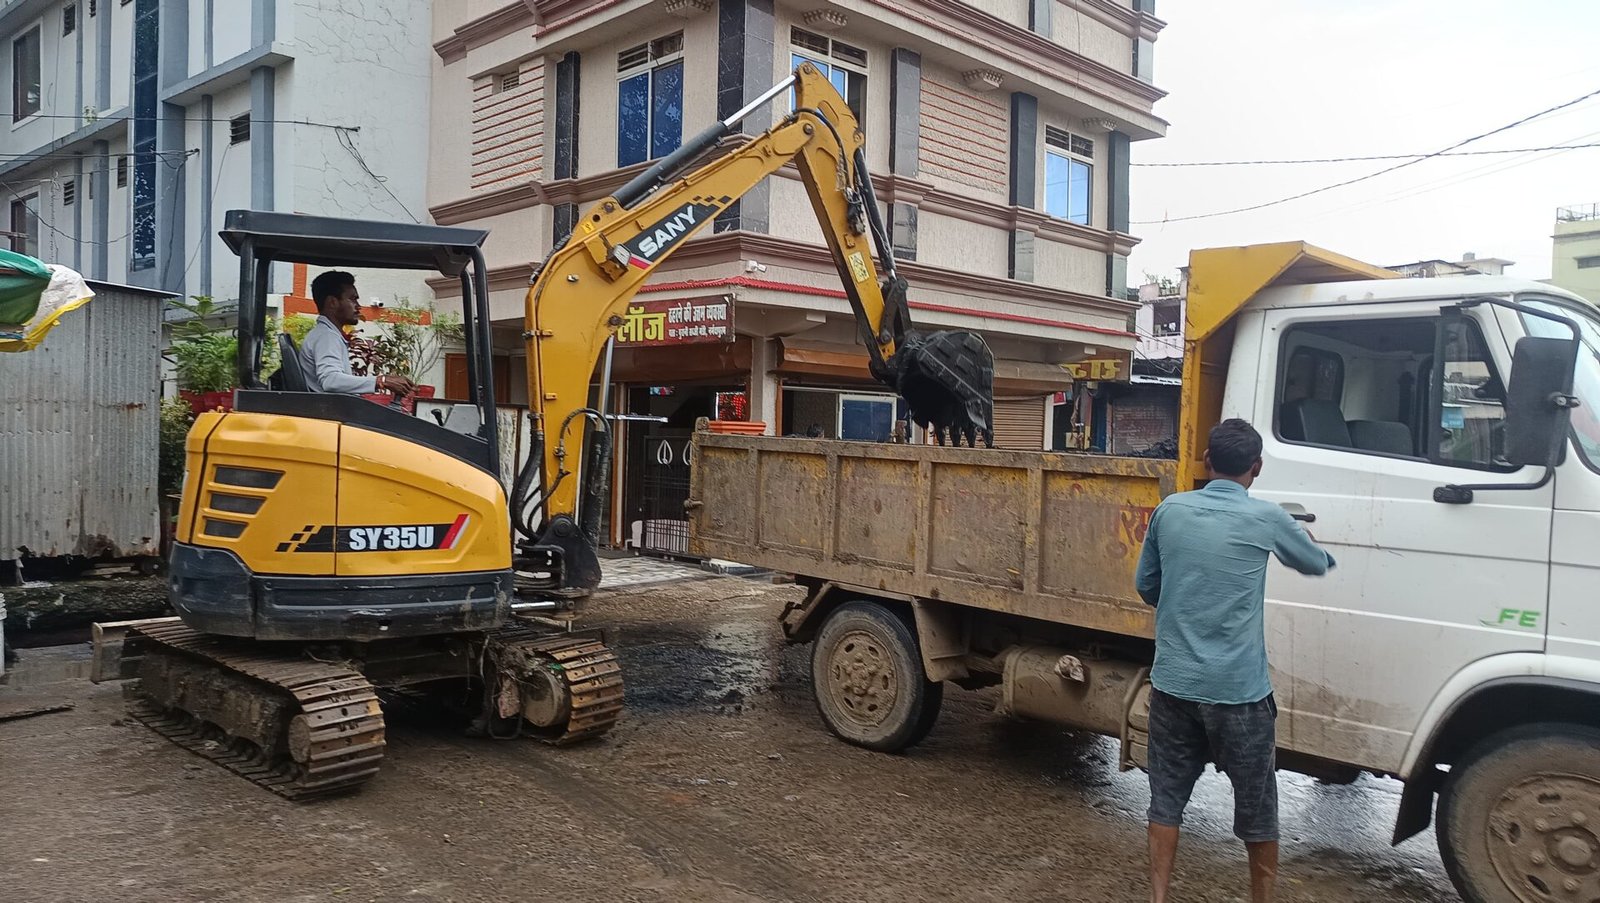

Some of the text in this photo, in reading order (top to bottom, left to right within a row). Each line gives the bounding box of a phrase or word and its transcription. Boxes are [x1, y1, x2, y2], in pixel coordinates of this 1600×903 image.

[638, 205, 696, 258] SANY
[683, 301, 692, 322] की
[617, 306, 667, 342] लॉज
[350, 526, 434, 550] SY35U
[1498, 608, 1540, 627] FE
